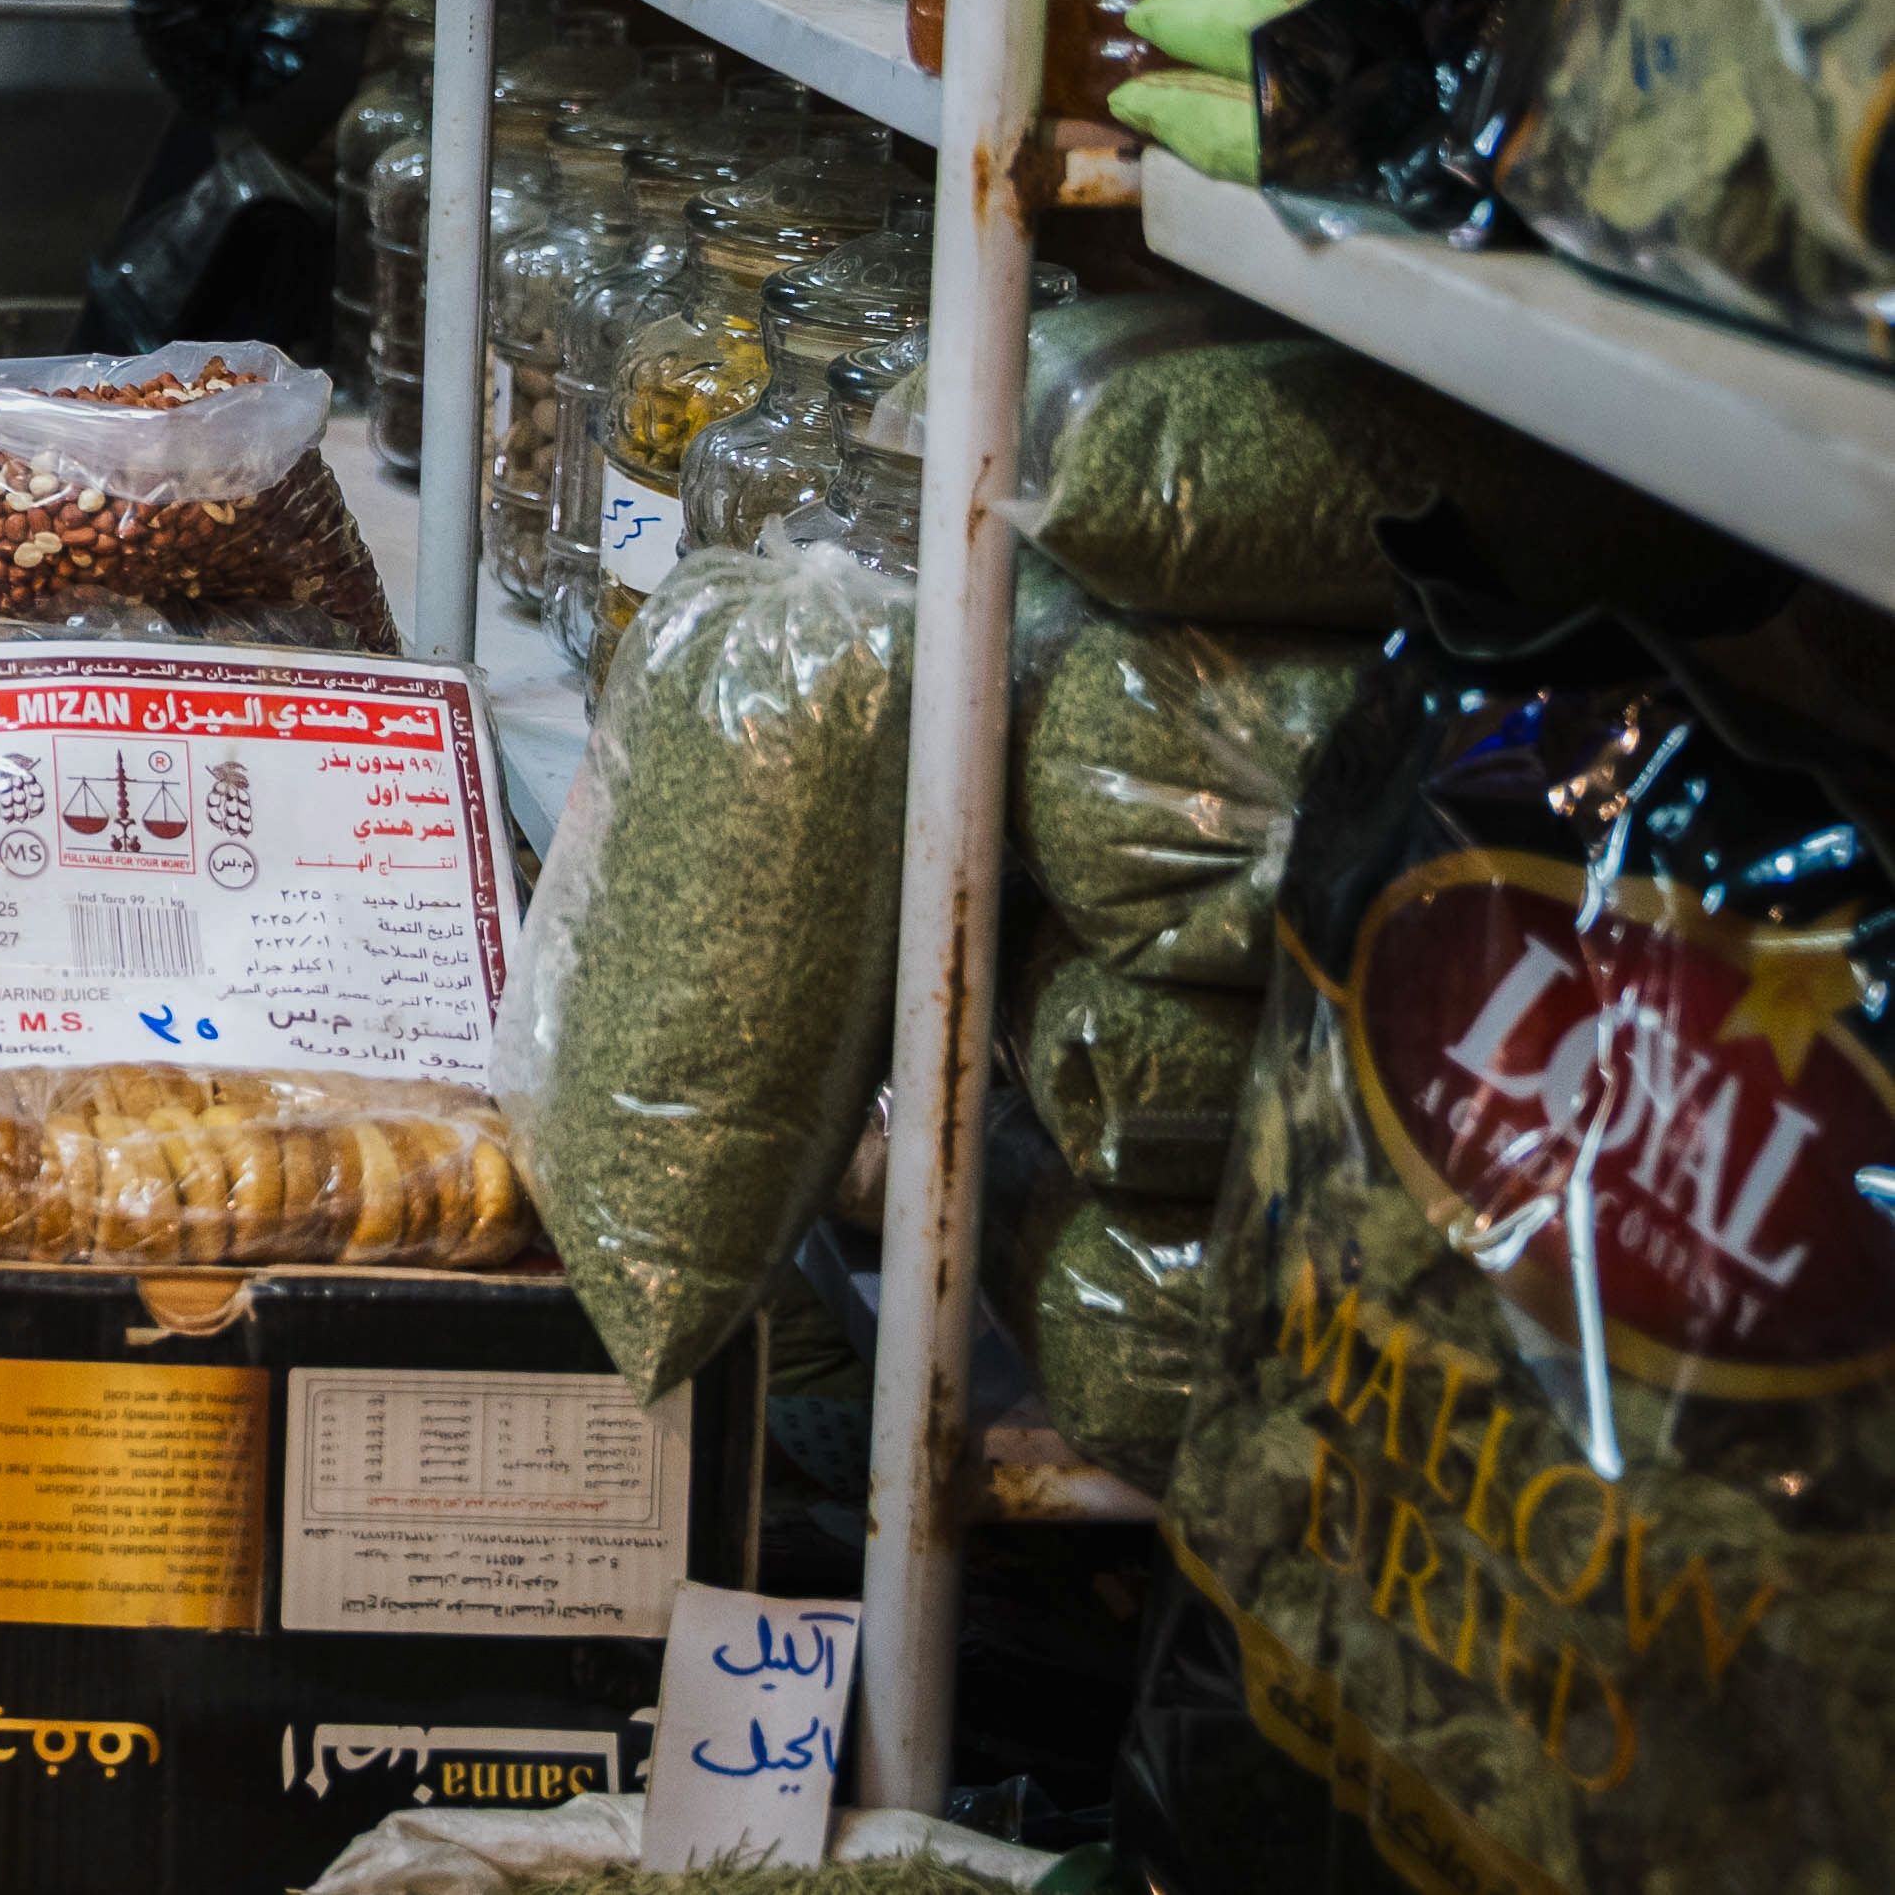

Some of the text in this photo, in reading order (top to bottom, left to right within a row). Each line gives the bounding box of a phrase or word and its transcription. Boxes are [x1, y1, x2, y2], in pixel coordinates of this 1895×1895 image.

[20, 660, 76, 677] الوحيد
[80, 661, 129, 674] هندي
[134, 662, 178, 679] التمر
[180, 666, 202, 681] هو
[207, 664, 266, 685] الميزان
[271, 669, 320, 688] ماركة
[324, 673, 377, 692] الهندي
[380, 678, 425, 696] التمر
[428, 680, 444, 698] أن
[17, 692, 131, 724] MIZAN
[142, 696, 436, 739] تمر هندي الميزان
[451, 707, 470, 740] أول
[317, 747, 404, 776] بدون بذر
[366, 778, 450, 806] نخب أول
[353, 817, 455, 841] تمر هندي
[3, 843, 43, 862] MS
[87, 855, 113, 866] VALUE
[115, 856, 133, 867] FOR
[135, 857, 160, 868] YOUR
[161, 857, 191, 870] MONEY
[279, 889, 462, 911] محصول جديد ٢٠٢٥
[428, 922, 463, 940] تاريخ
[362, 942, 469, 966] تاريخ الصلاحية
[246, 959, 472, 991] الوزن الصافي كيلو جرام
[61, 987, 111, 1002] JUICE
[19, 1012, 94, 1032] M.S.
[419, 1055, 484, 1071] سوق
[1443, 934, 1820, 1288] LOYAL
[1278, 1259, 1780, 1680] MALLOW
[1307, 1435, 1639, 1793] DRIED
